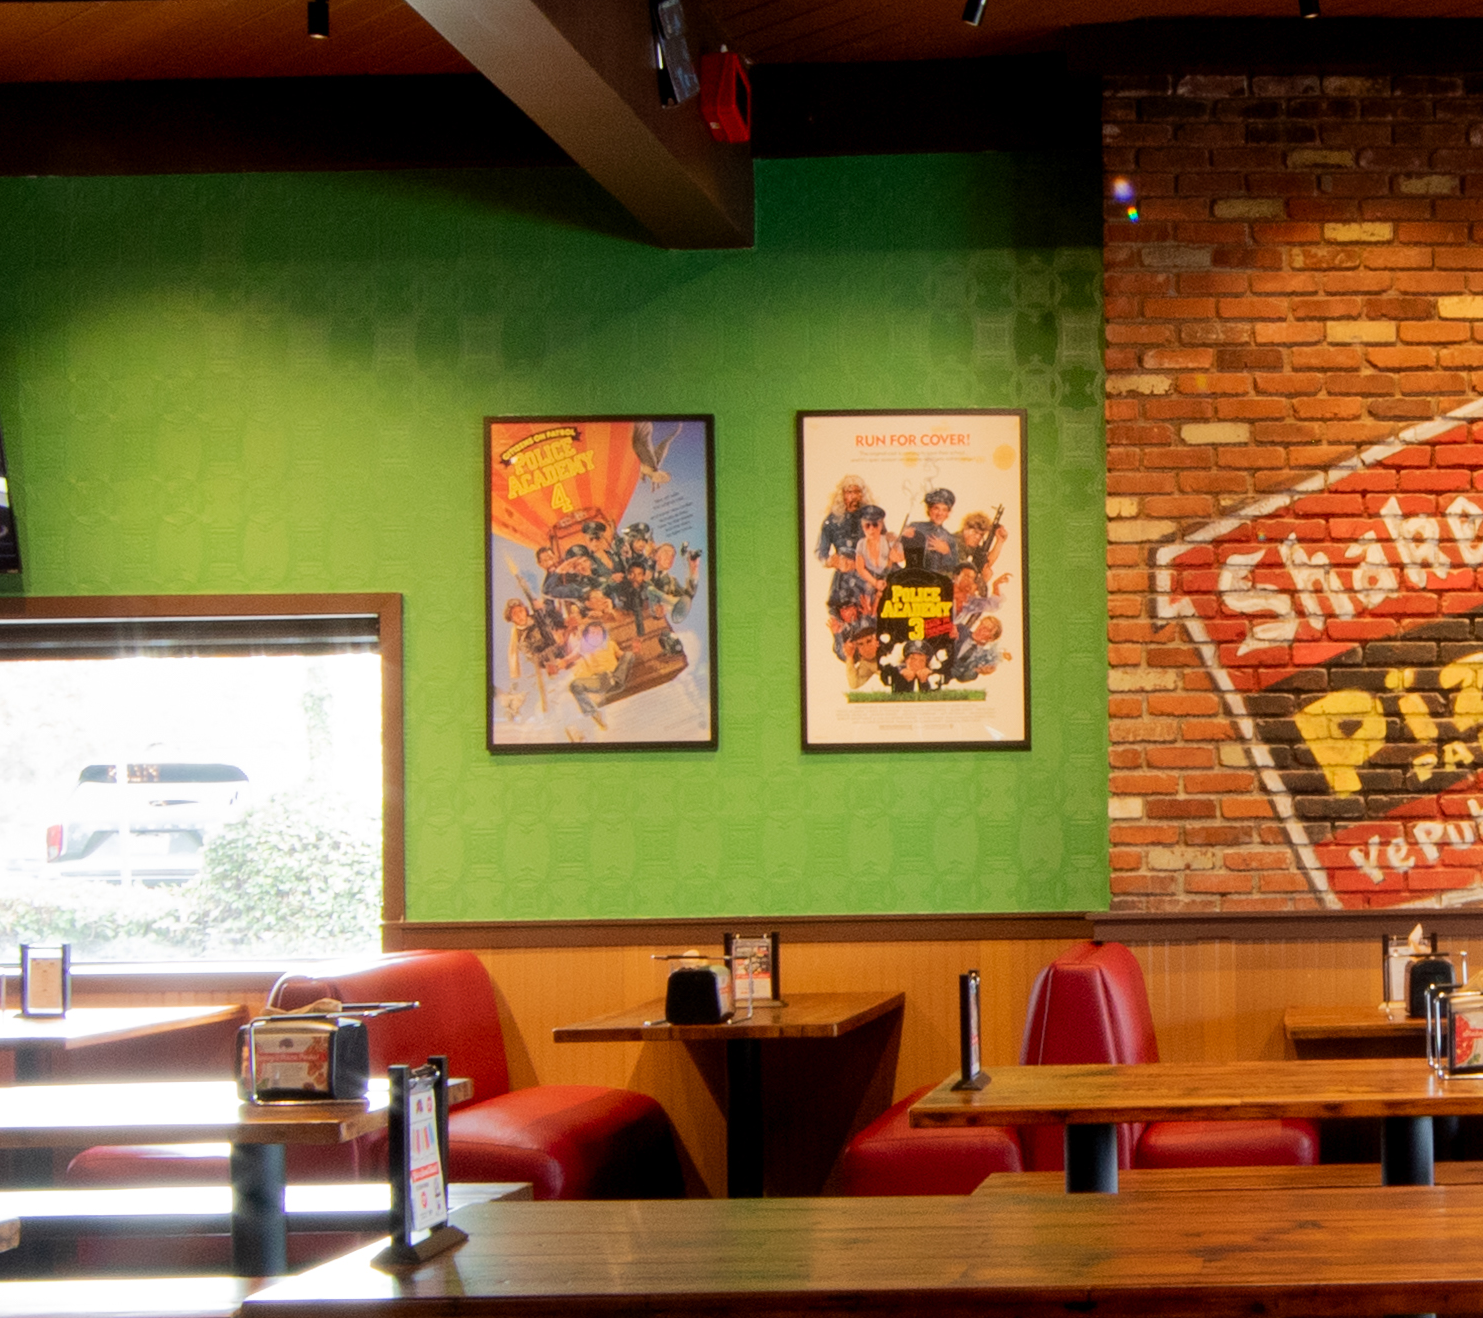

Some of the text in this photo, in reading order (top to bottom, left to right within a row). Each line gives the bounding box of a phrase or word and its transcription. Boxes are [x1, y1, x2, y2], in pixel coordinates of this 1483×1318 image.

[855, 433, 972, 448] RUN FOR COVER!
[513, 435, 577, 477] POLICE
[507, 449, 596, 501] ACADEMY
[551, 482, 575, 514] 4
[891, 584, 942, 603] POLICE
[880, 599, 954, 618] ACADEMY
[908, 617, 926, 641] 3
[1348, 834, 1416, 885] Ye
